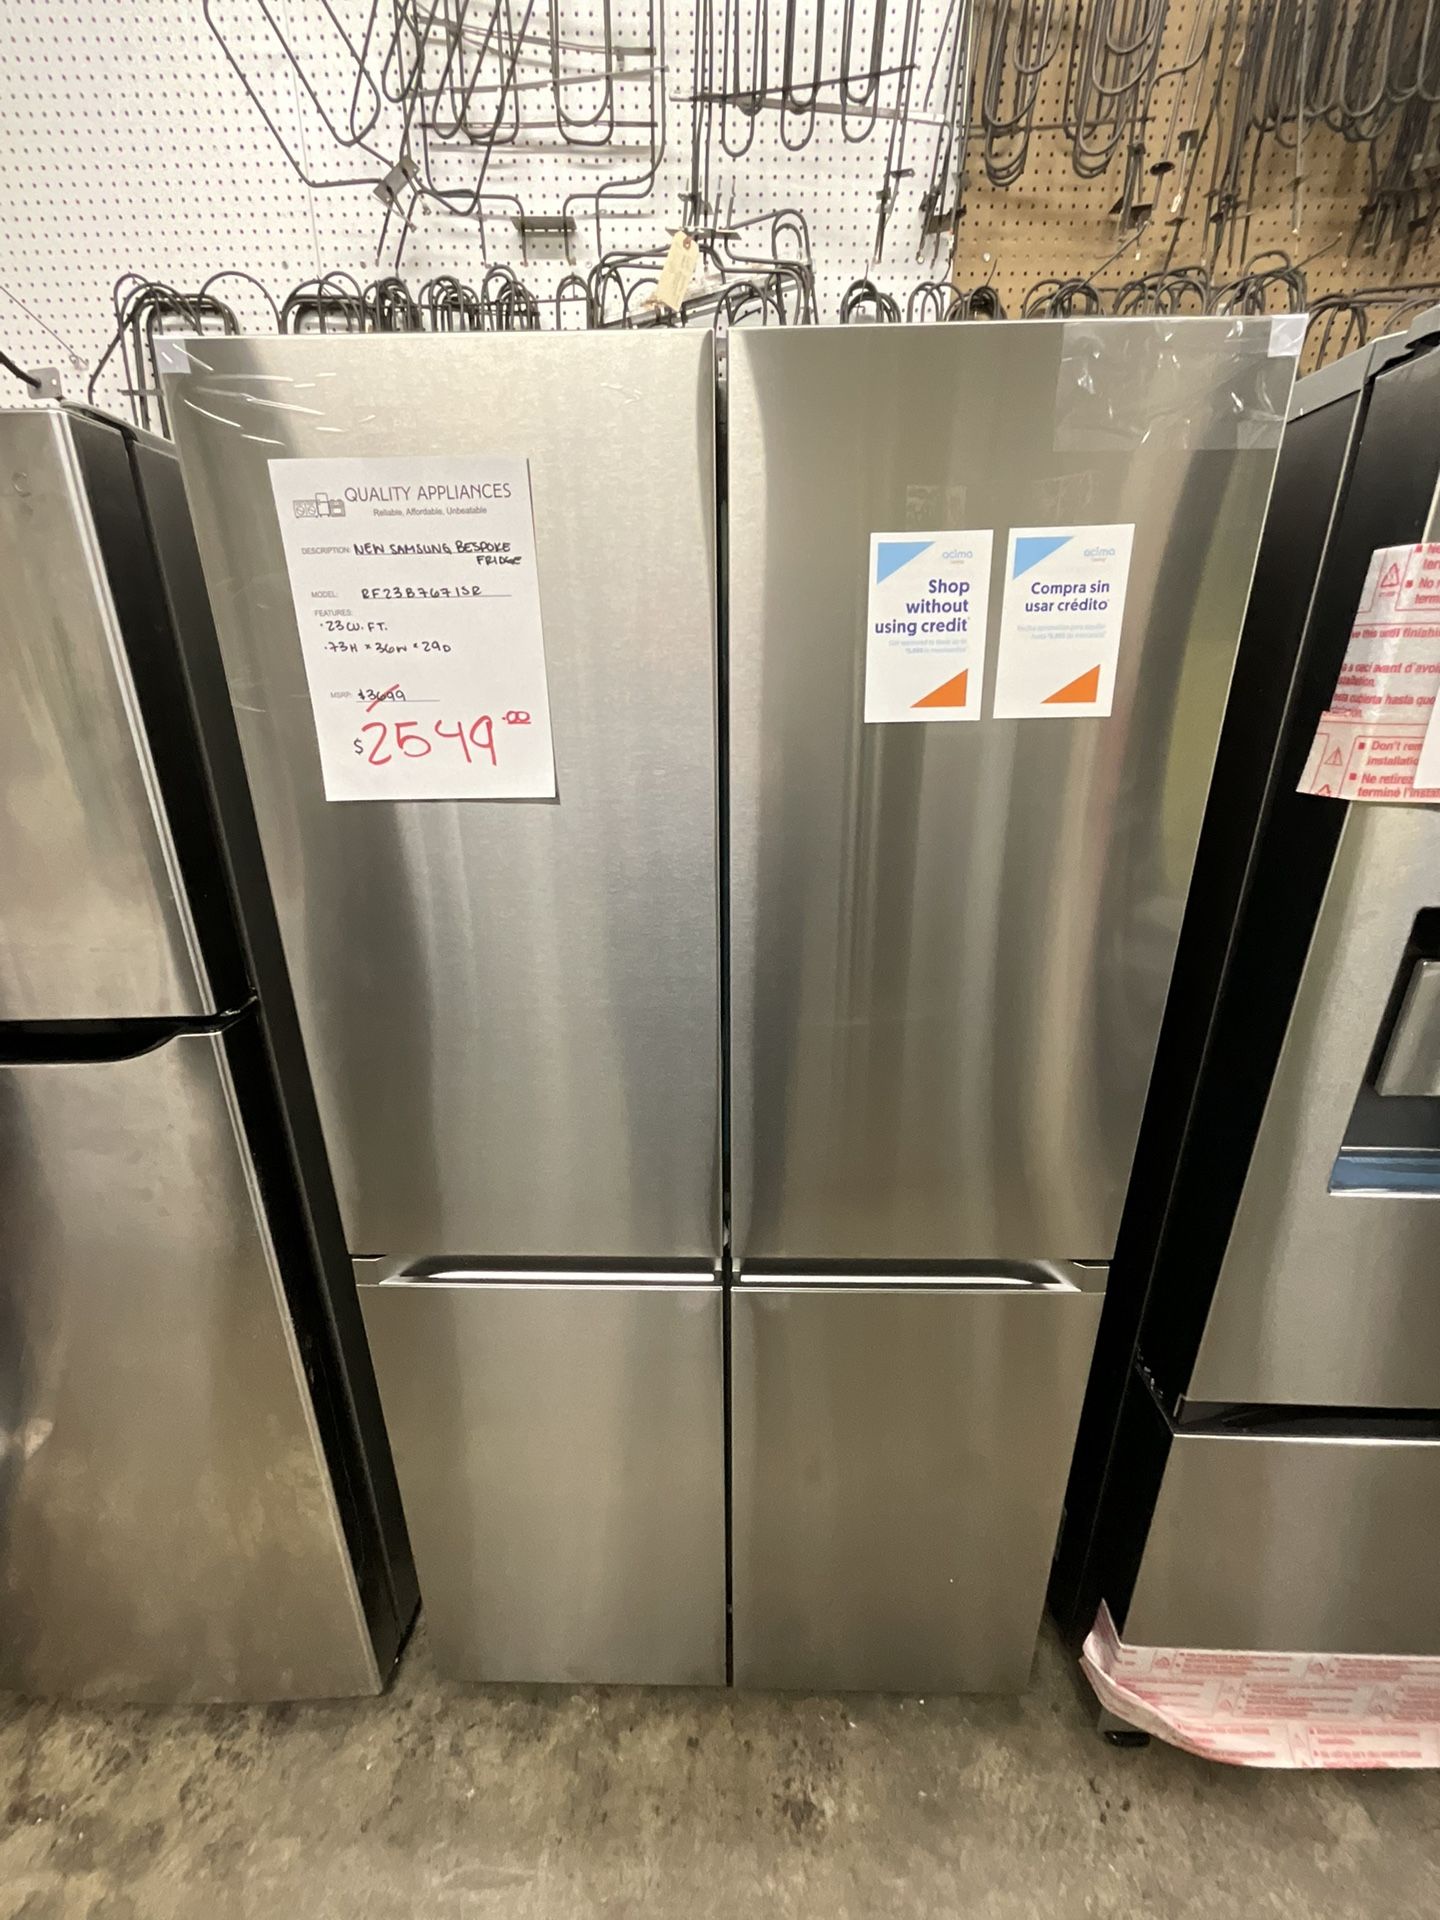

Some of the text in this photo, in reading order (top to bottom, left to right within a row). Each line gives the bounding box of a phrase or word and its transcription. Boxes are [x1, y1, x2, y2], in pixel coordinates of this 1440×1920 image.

[344, 483, 512, 502] QUALITY APPLIANCES
[373, 506, 487, 517] Reliable, Affordable, Unbeatable
[353, 542, 385, 555] NEW
[389, 543, 451, 555] SAMSUNG
[455, 540, 511, 554] BESPOKE
[928, 578, 970, 596] Shop
[1031, 580, 1110, 597] Compra sin
[906, 598, 968, 614] without
[1025, 597, 1108, 612] usar crédito
[875, 617, 968, 637] using credit
